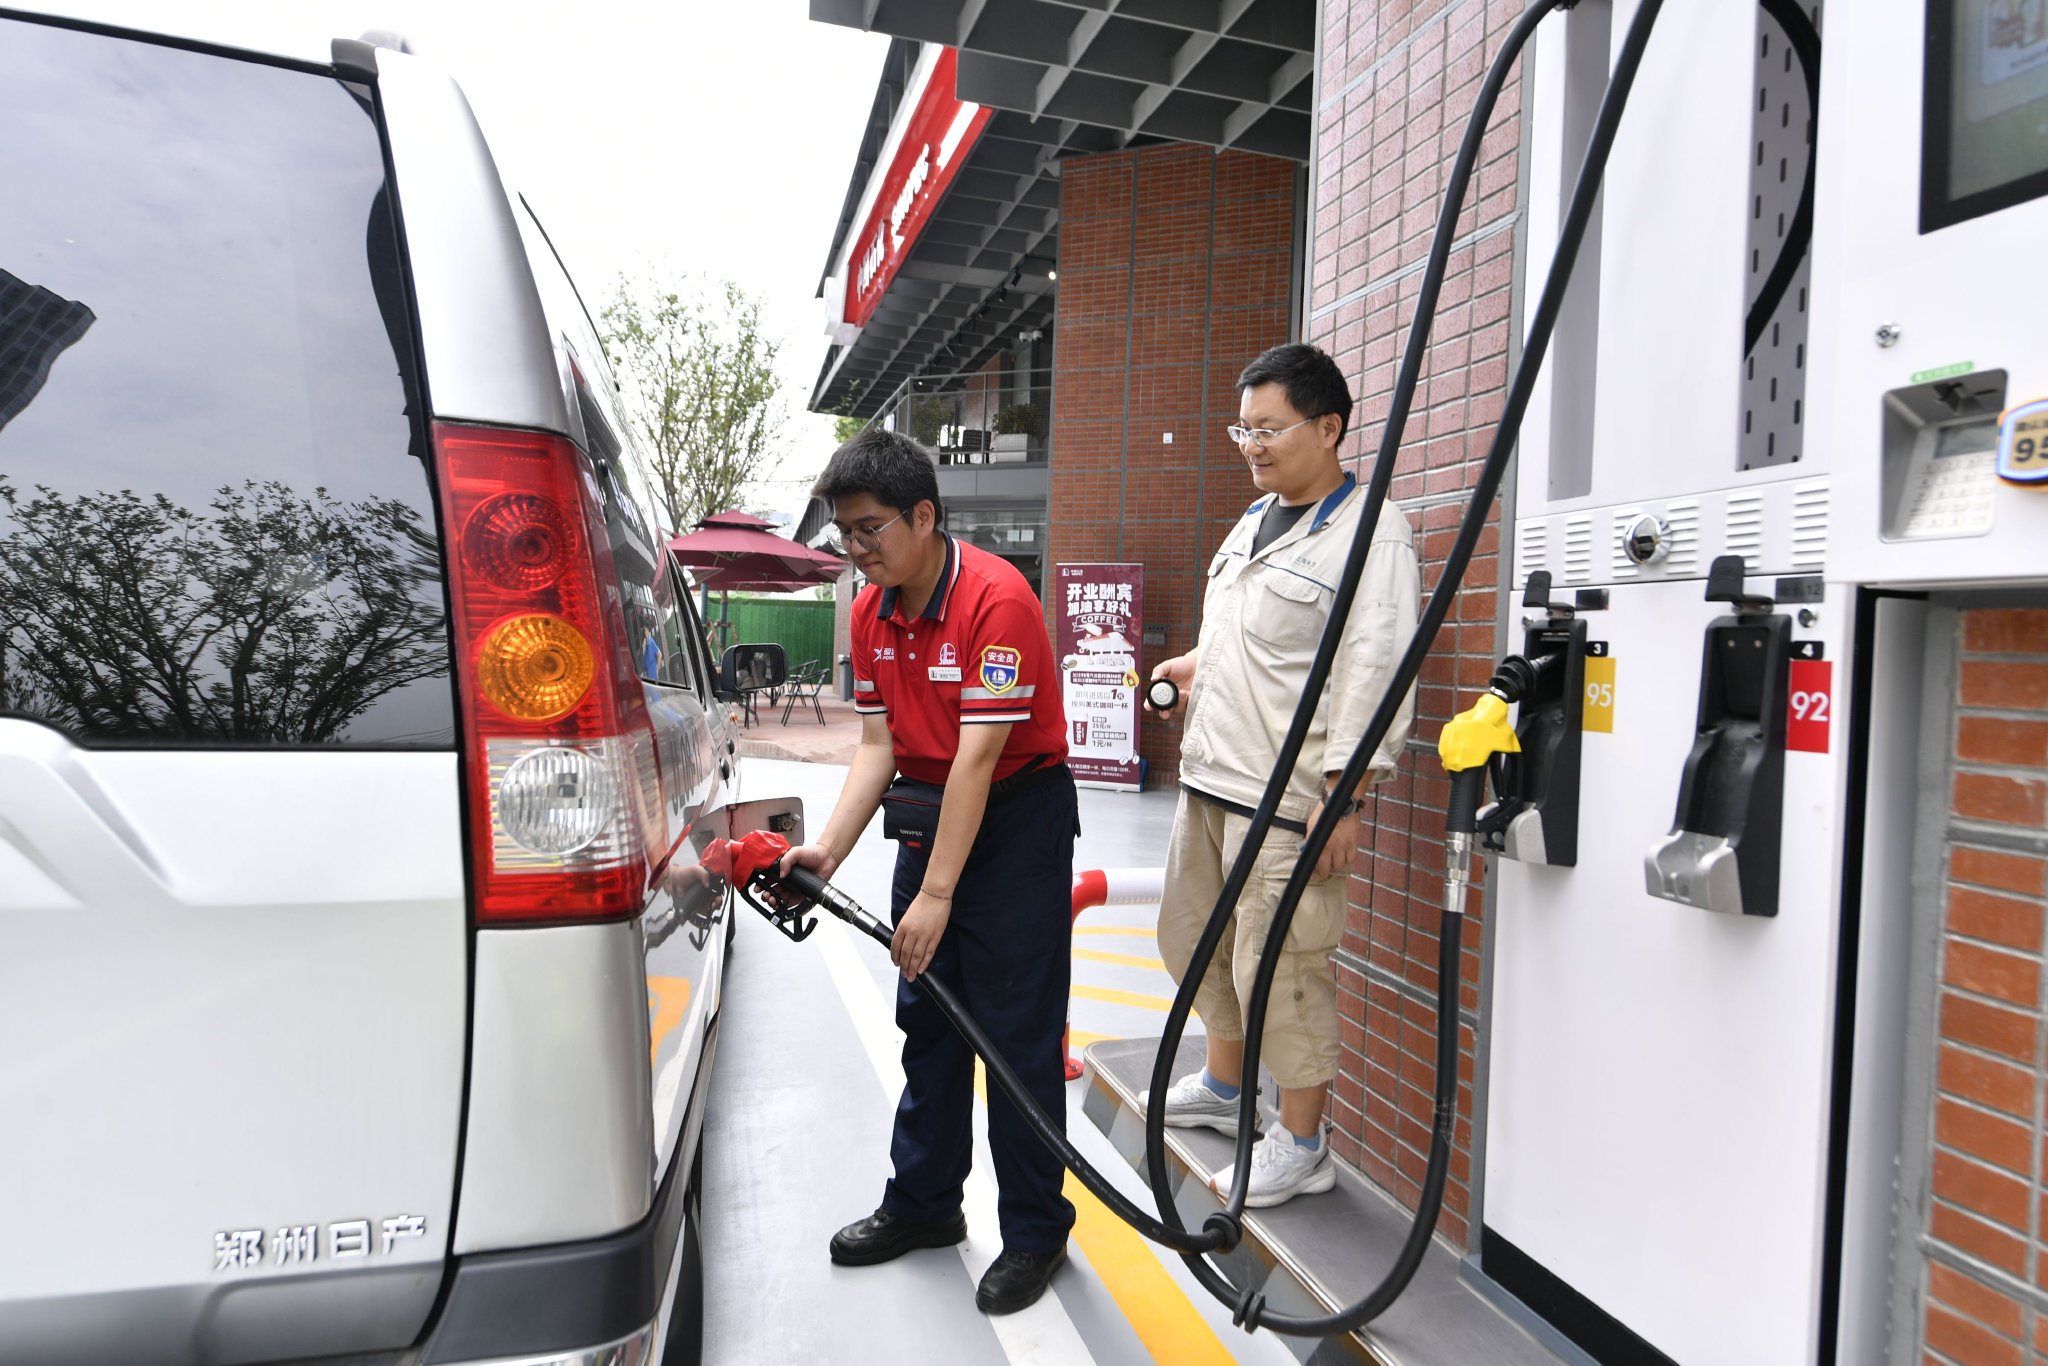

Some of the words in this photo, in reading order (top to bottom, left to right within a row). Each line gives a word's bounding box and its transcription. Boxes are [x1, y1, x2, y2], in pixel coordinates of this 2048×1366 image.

[1066, 583, 1132, 602] 开业酬宾
[1067, 600, 1132, 617] 加油享好礼
[1081, 616, 1118, 624] COFFEE
[1594, 643, 1601, 655] 3
[1802, 643, 1813, 656] 4
[987, 652, 1014, 664] 安全员
[1587, 683, 1612, 707] 95
[1790, 691, 1829, 722] 92
[1092, 740, 1112, 748] 1元/杯
[213, 1214, 426, 1272] 郑州日产
